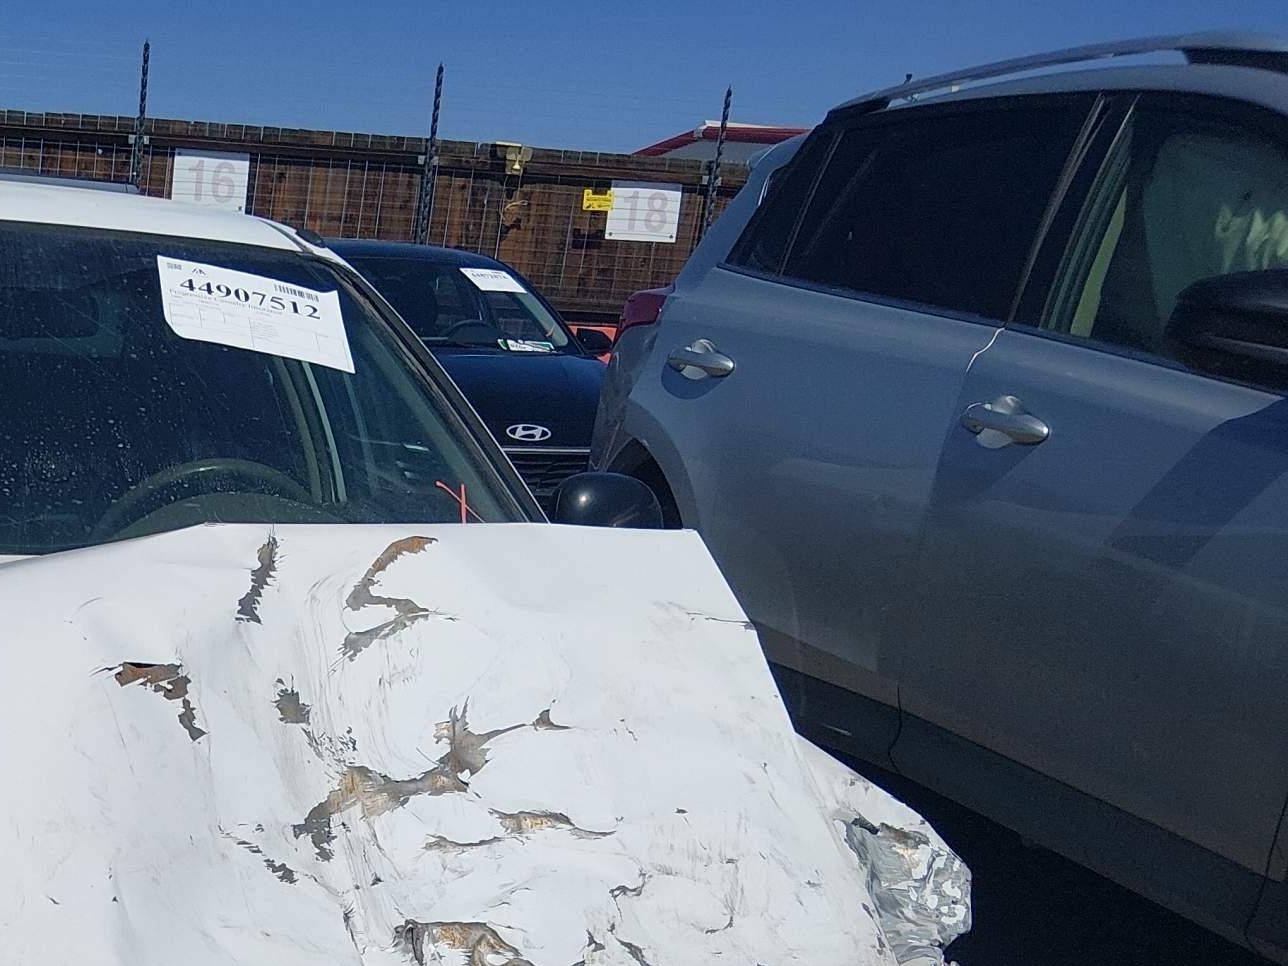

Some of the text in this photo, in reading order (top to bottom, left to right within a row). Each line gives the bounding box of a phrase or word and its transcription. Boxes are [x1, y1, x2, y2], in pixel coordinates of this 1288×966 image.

[188, 159, 235, 203] 16
[624, 191, 668, 232] 18
[179, 278, 321, 320] 44907512
